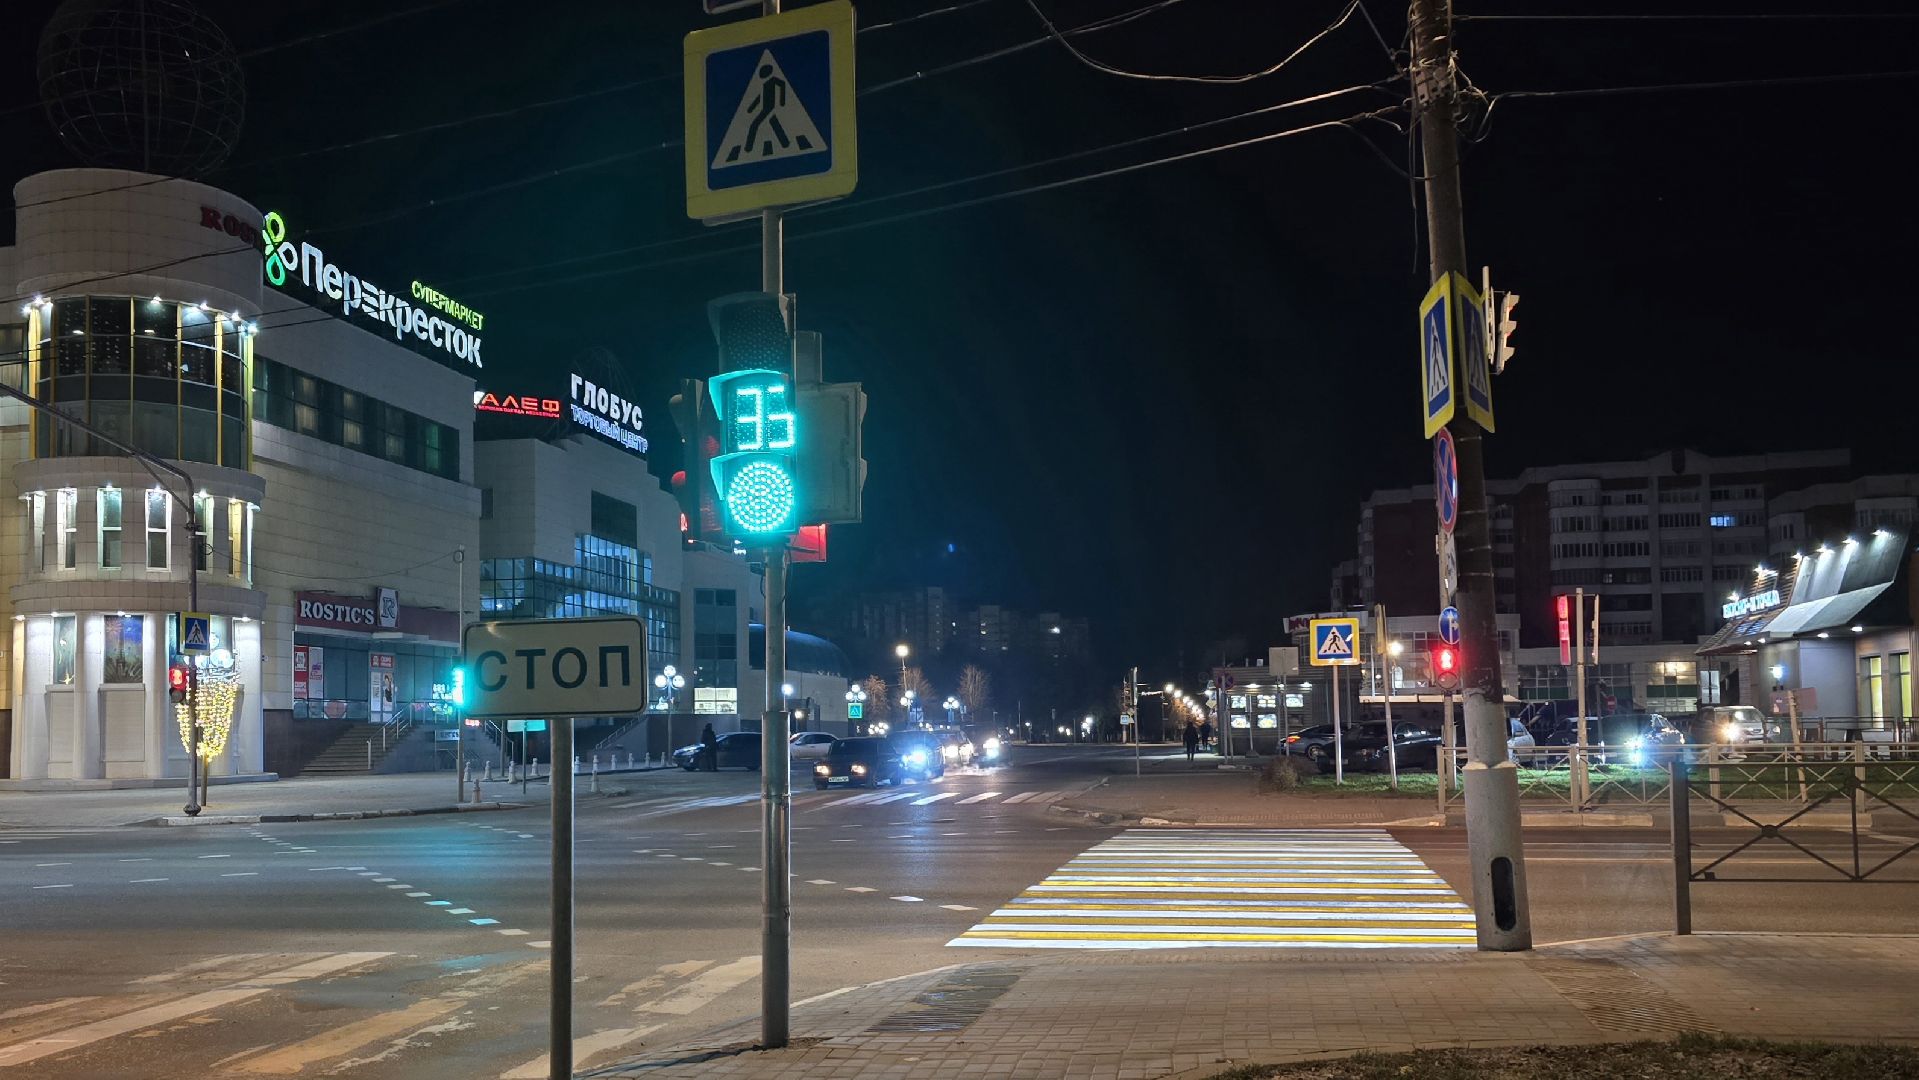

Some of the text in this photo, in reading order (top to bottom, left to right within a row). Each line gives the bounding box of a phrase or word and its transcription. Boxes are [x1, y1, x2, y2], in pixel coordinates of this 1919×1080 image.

[302, 241, 483, 368] Перекресток
[411, 280, 484, 331] СУПЕРМАРКЕТ
[571, 373, 643, 431] ГЛОБУС
[736, 384, 796, 451] 35
[571, 403, 649, 454] ТОРГОВЫЙ ЦЕНТР
[300, 599, 375, 625] ROSTIC'S
[474, 645, 631, 692] СТОП
